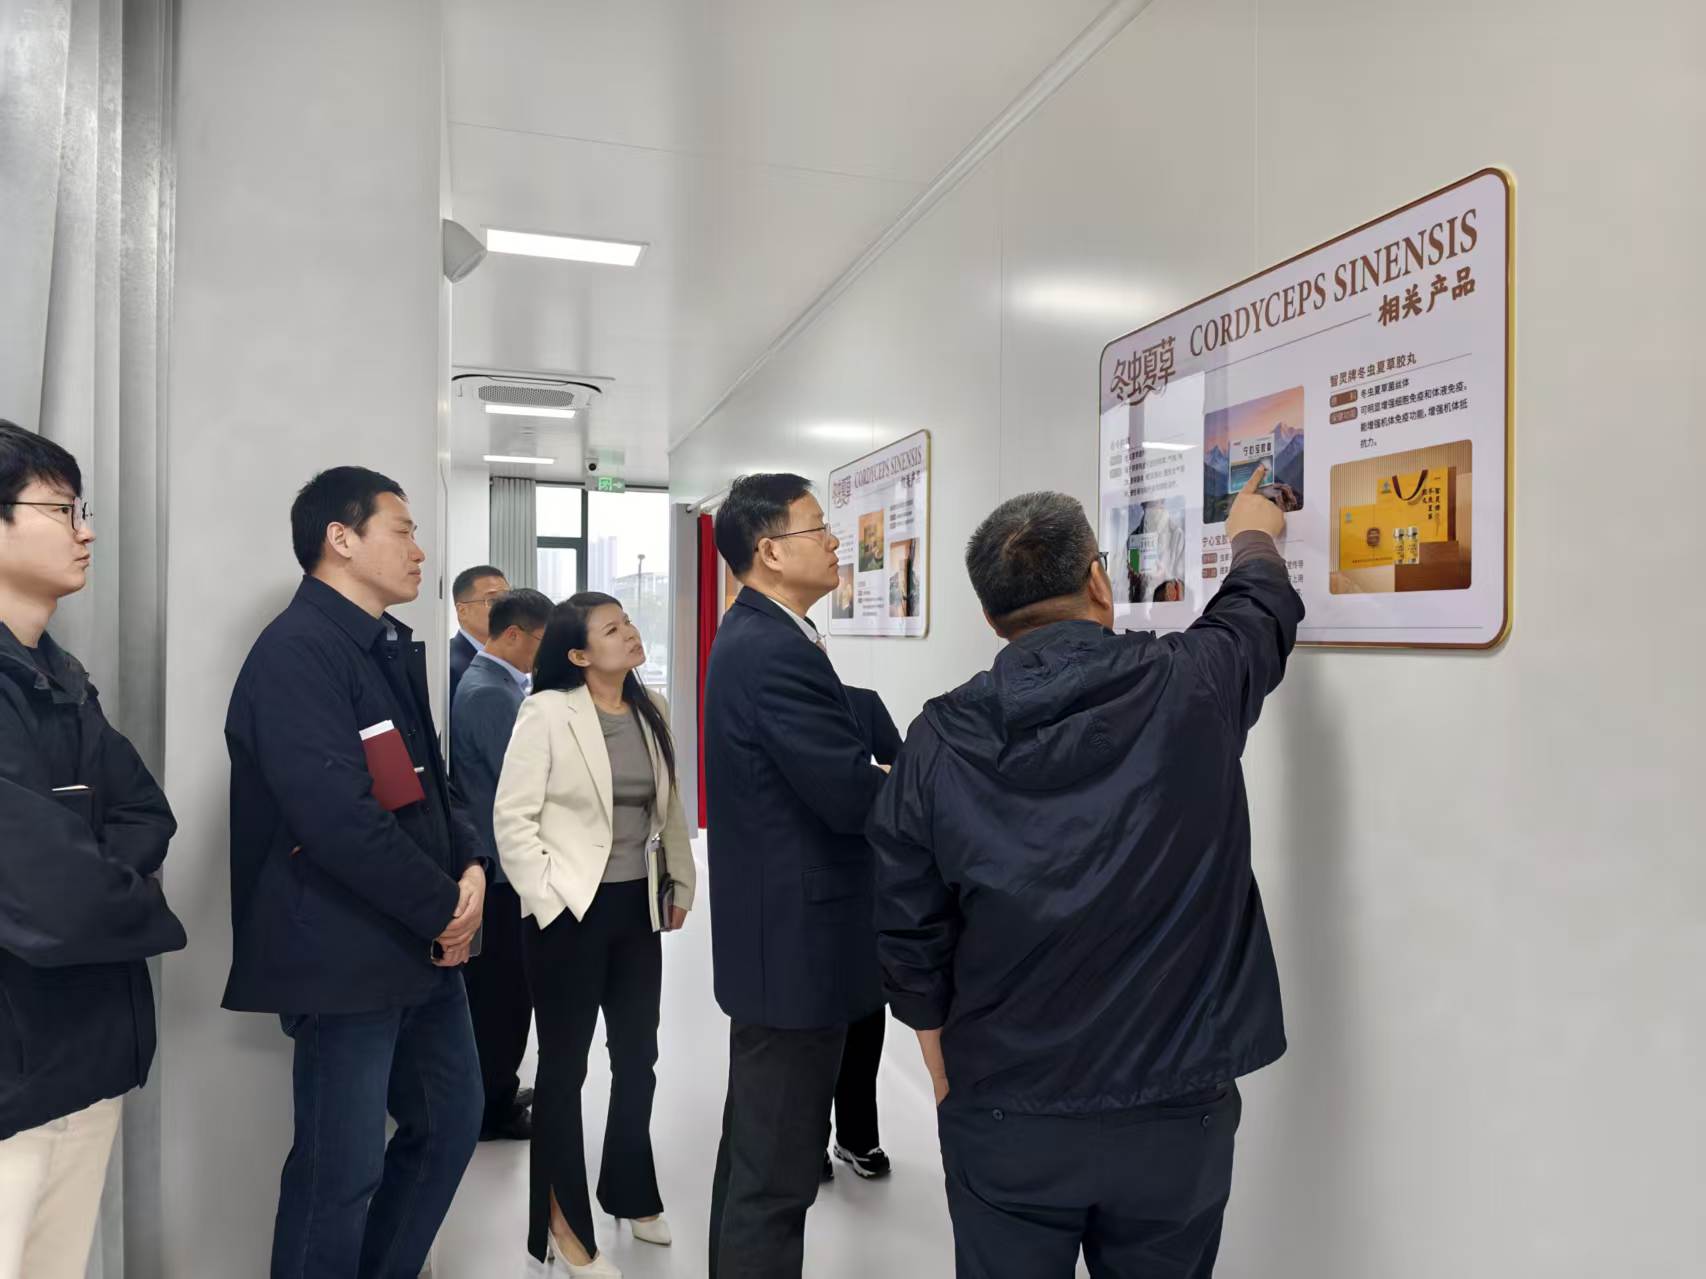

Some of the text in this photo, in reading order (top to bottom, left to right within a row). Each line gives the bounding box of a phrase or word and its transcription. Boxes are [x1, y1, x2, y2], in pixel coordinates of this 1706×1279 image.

[1190, 208, 1478, 358] CORDYCEPS SINENSIS
[1377, 265, 1476, 328] 相关产品
[1109, 336, 1176, 407] 冬虫夏草
[1329, 351, 1417, 388] 智灵牌冬虫夏草胶丸
[1360, 378, 1410, 399] 冬虫夏草菌丝体
[1201, 534, 1232, 548] 宁心宝胶
